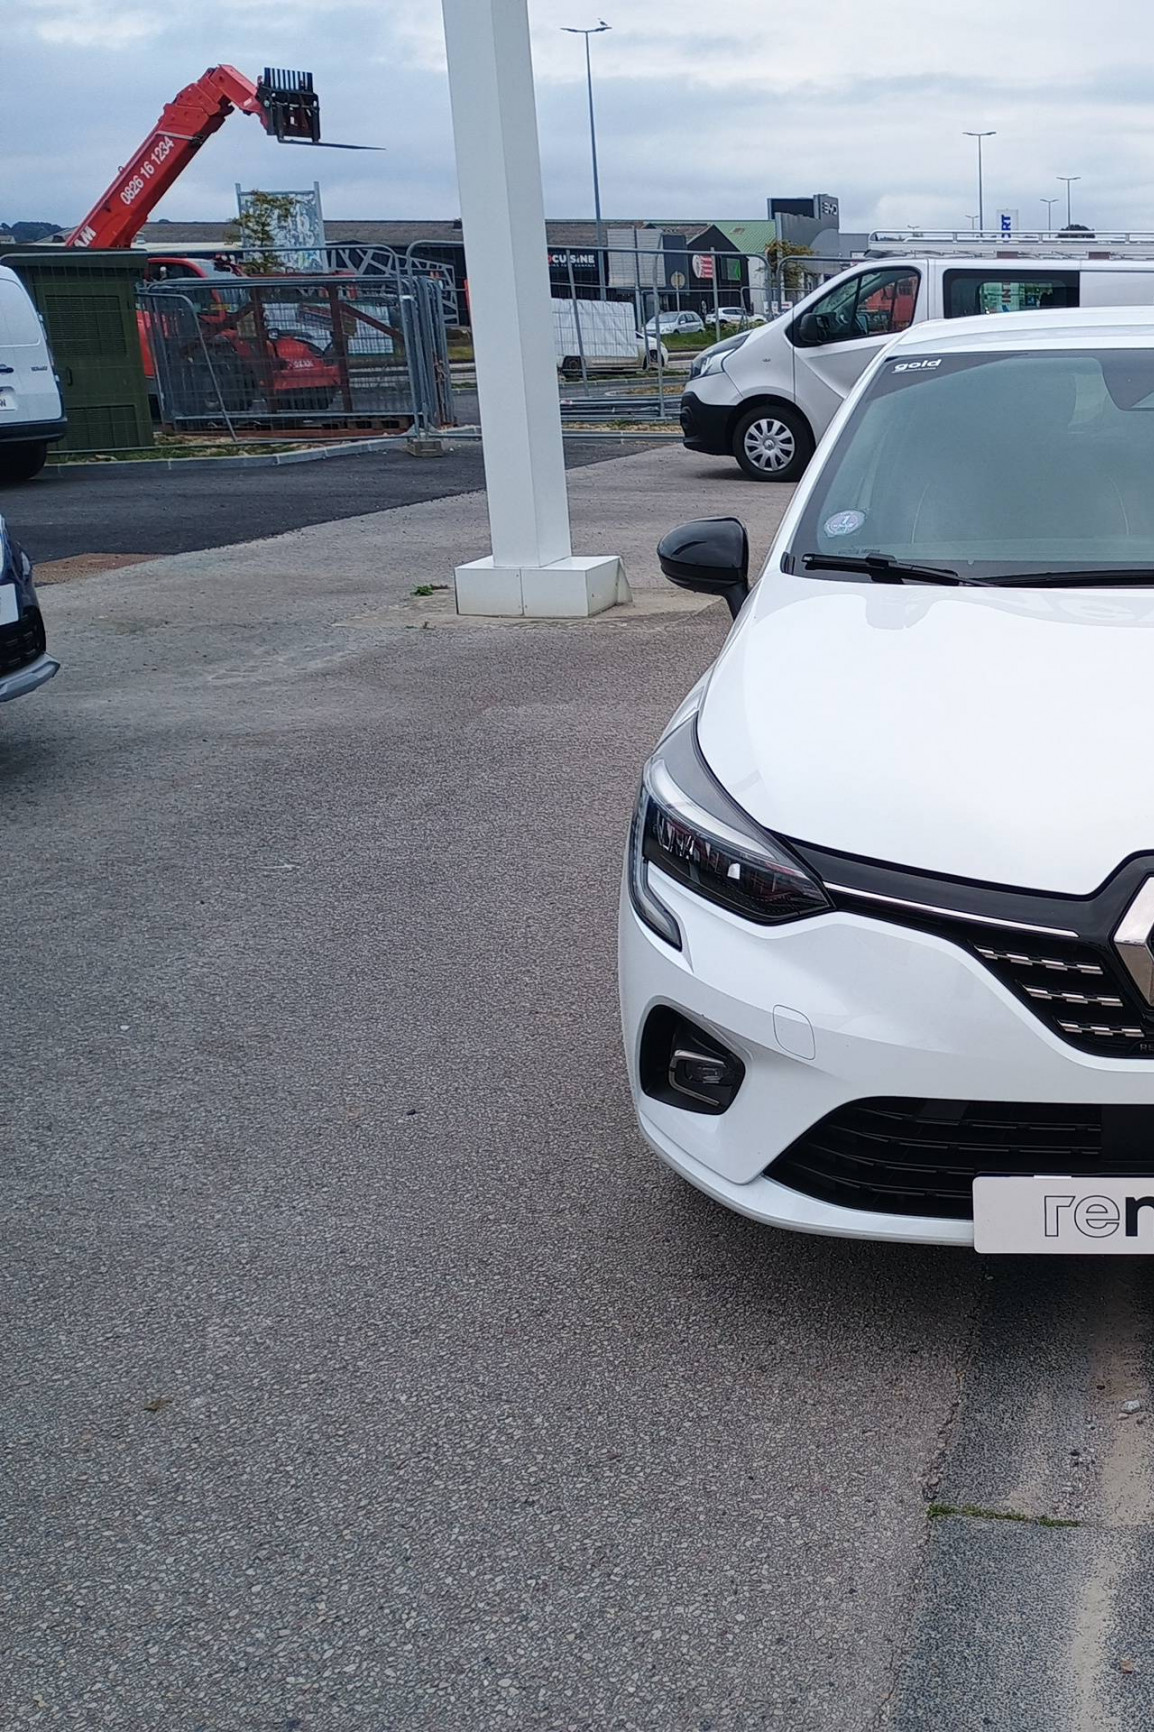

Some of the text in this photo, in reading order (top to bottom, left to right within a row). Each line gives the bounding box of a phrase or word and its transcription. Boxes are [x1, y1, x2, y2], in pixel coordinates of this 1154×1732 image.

[120, 136, 174, 205] 0826 16 1234
[894, 359, 942, 371] gold
